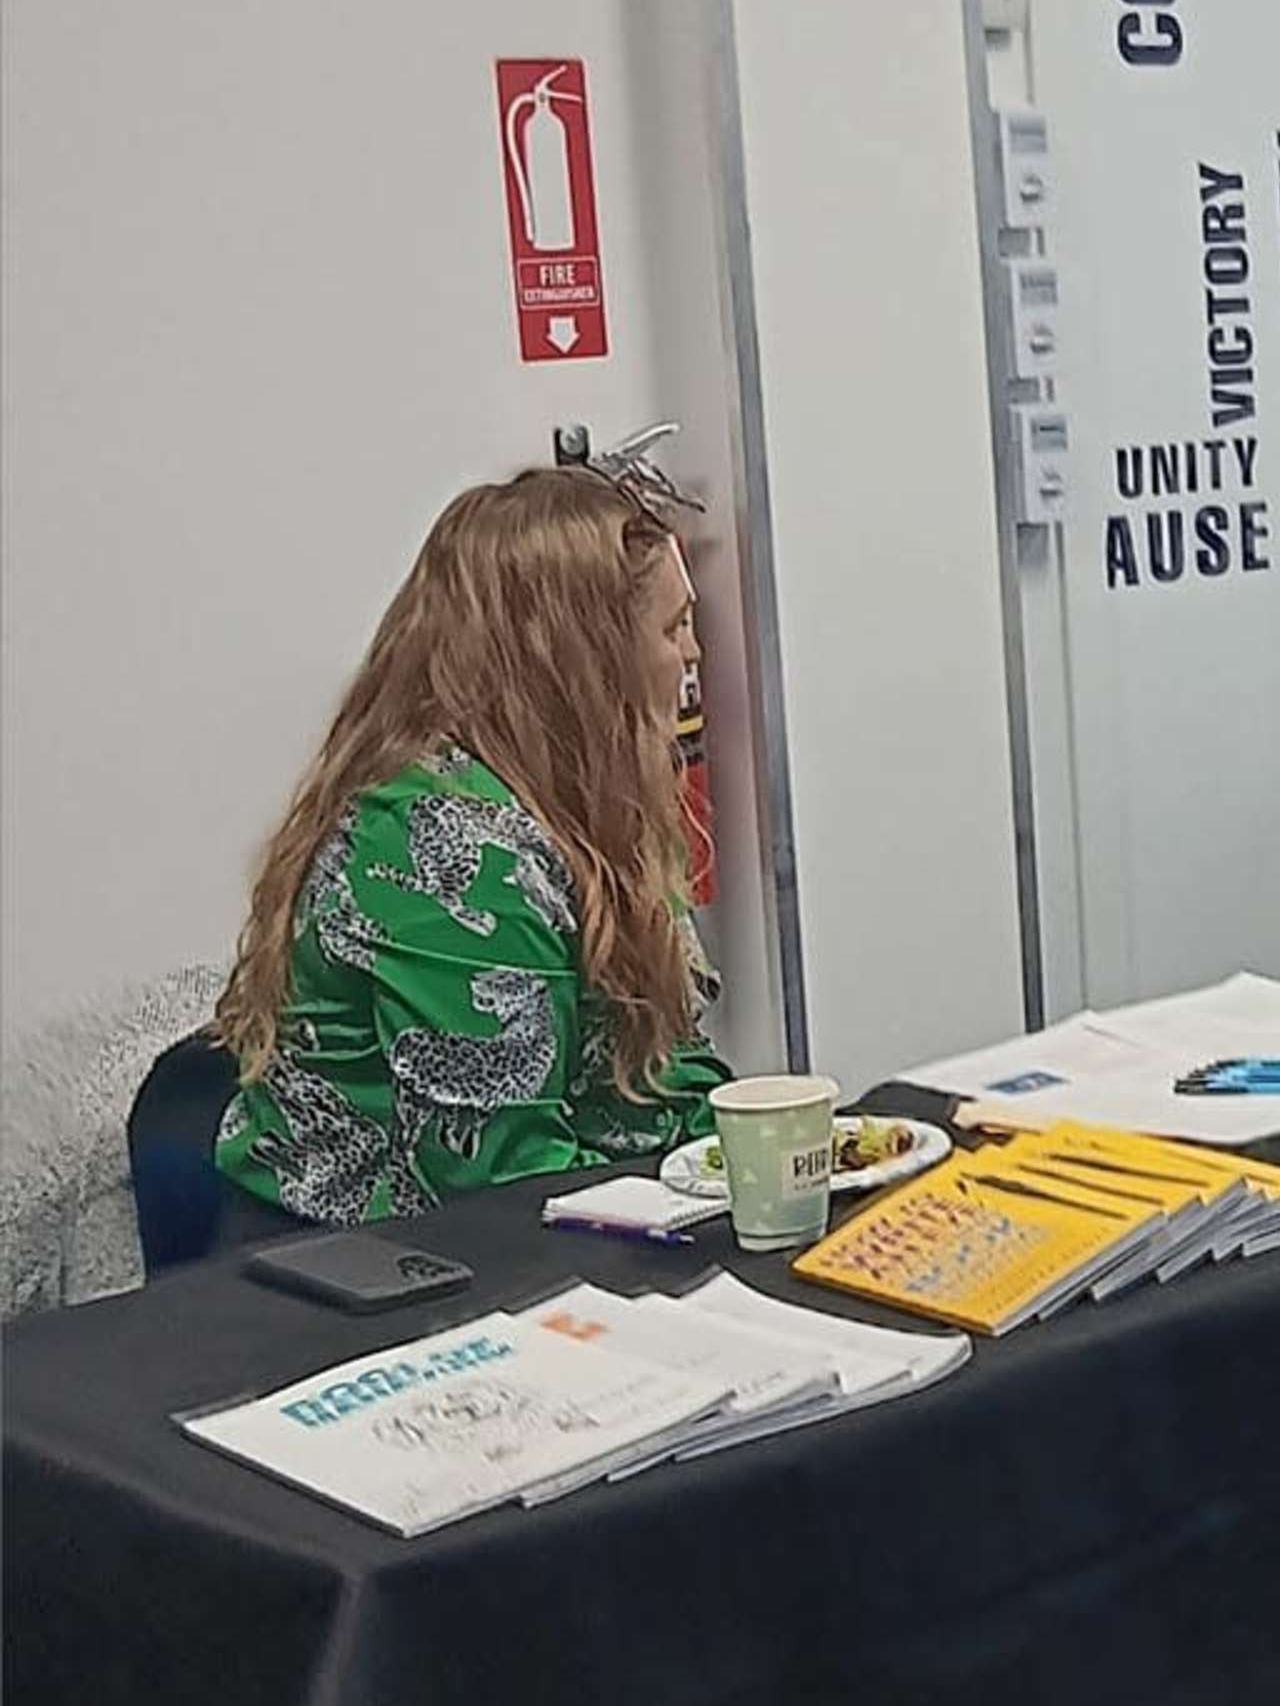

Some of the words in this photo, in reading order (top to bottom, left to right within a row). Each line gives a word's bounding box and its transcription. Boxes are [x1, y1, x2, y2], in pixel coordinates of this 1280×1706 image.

[539, 264, 576, 287] FIRE
[1199, 161, 1256, 428] VICTORY
[1116, 437, 1257, 499] UNITY
[1106, 502, 1270, 589] AUSE
